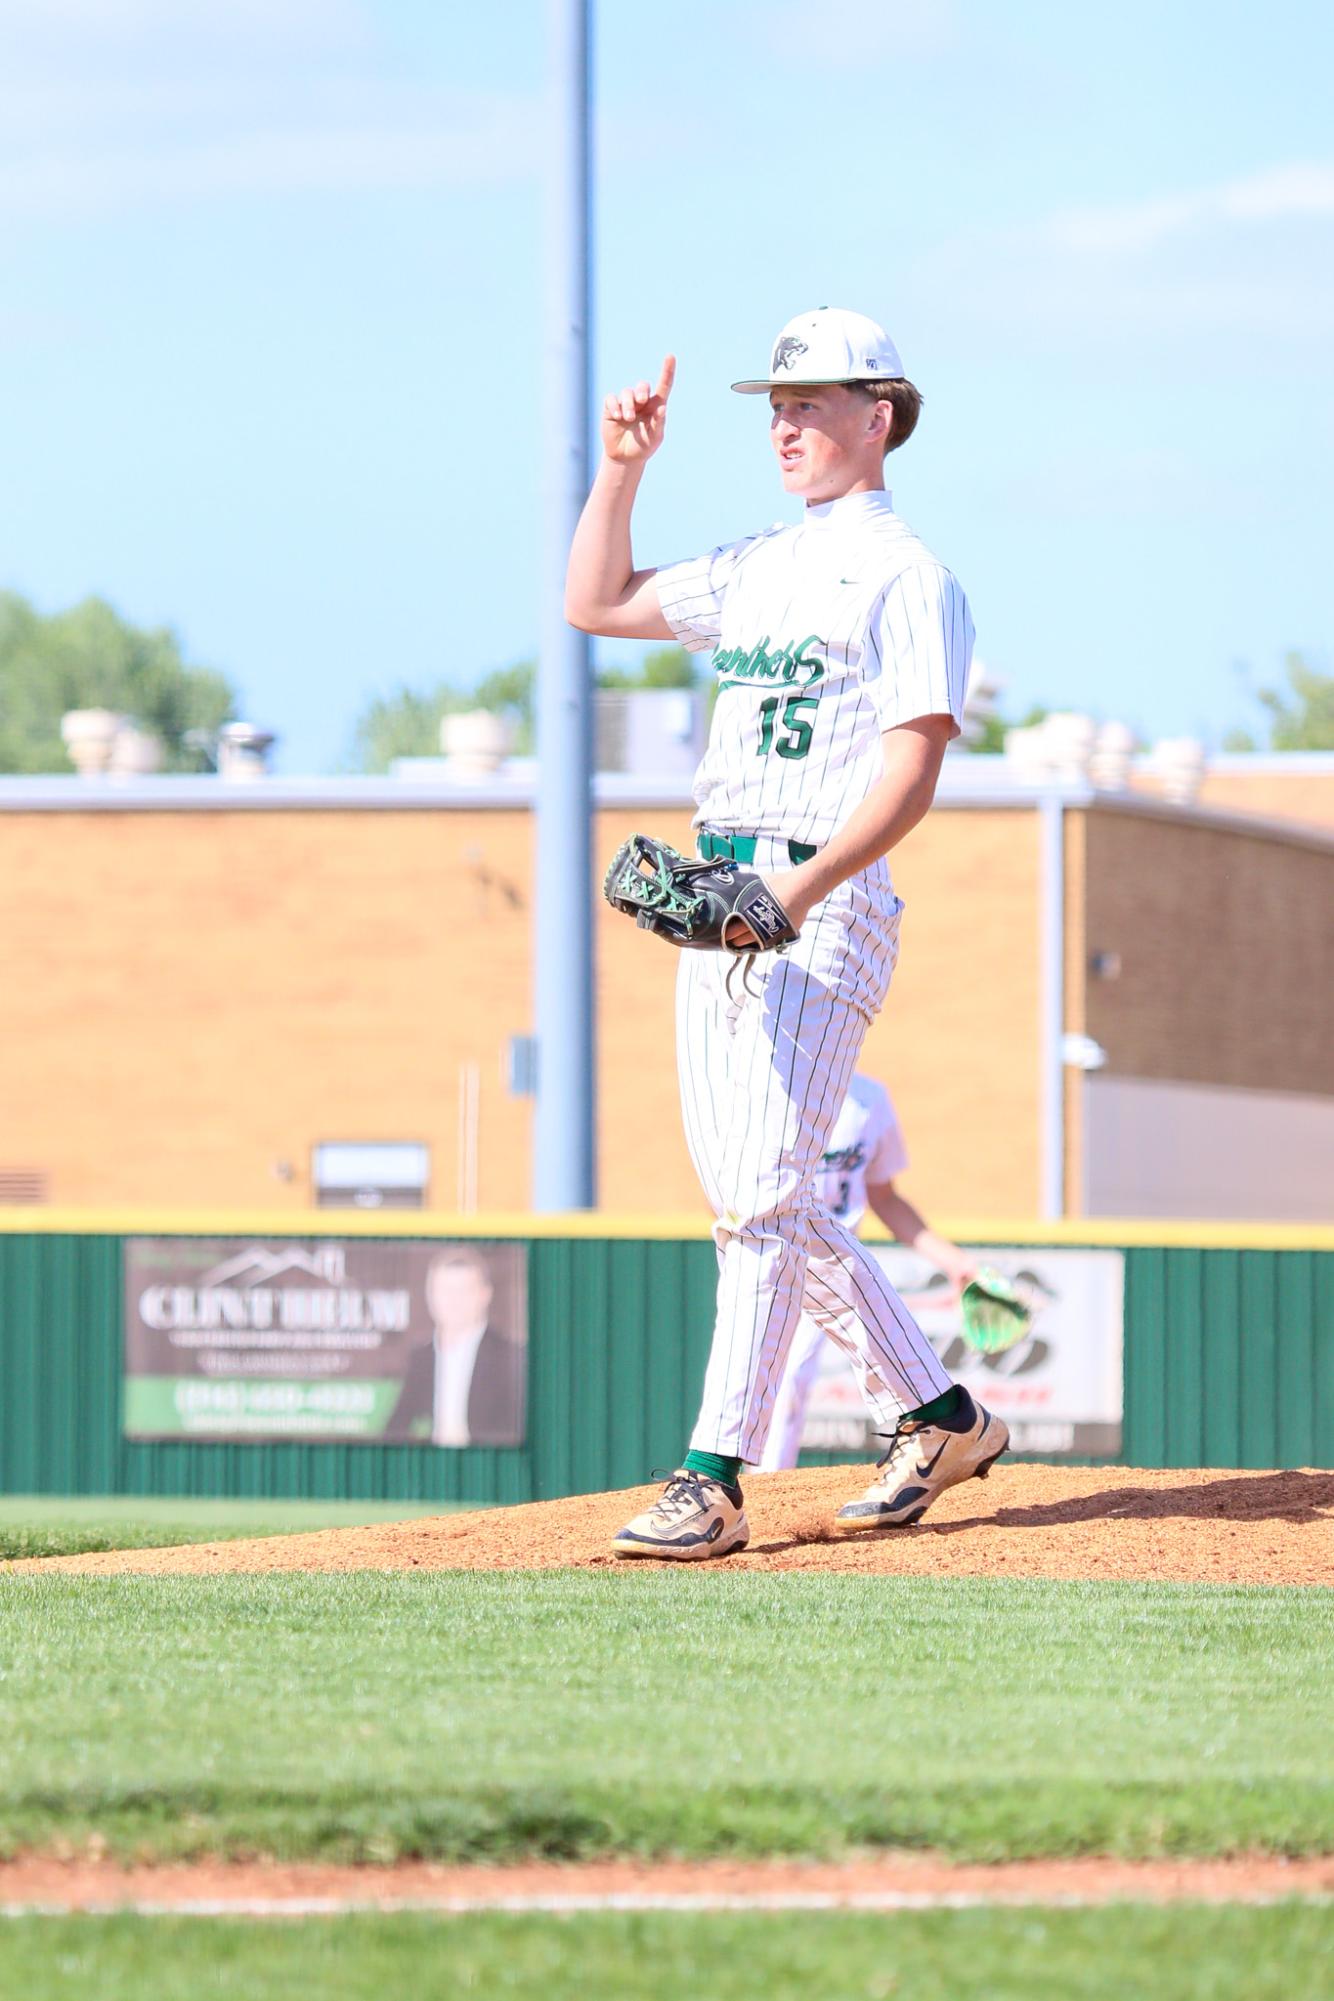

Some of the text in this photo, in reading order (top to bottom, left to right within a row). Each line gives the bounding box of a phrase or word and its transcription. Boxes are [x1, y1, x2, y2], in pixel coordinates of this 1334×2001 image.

[713, 634, 825, 688] anthers
[756, 696, 820, 760] 15
[139, 1286, 411, 1332] CLINT HELM
